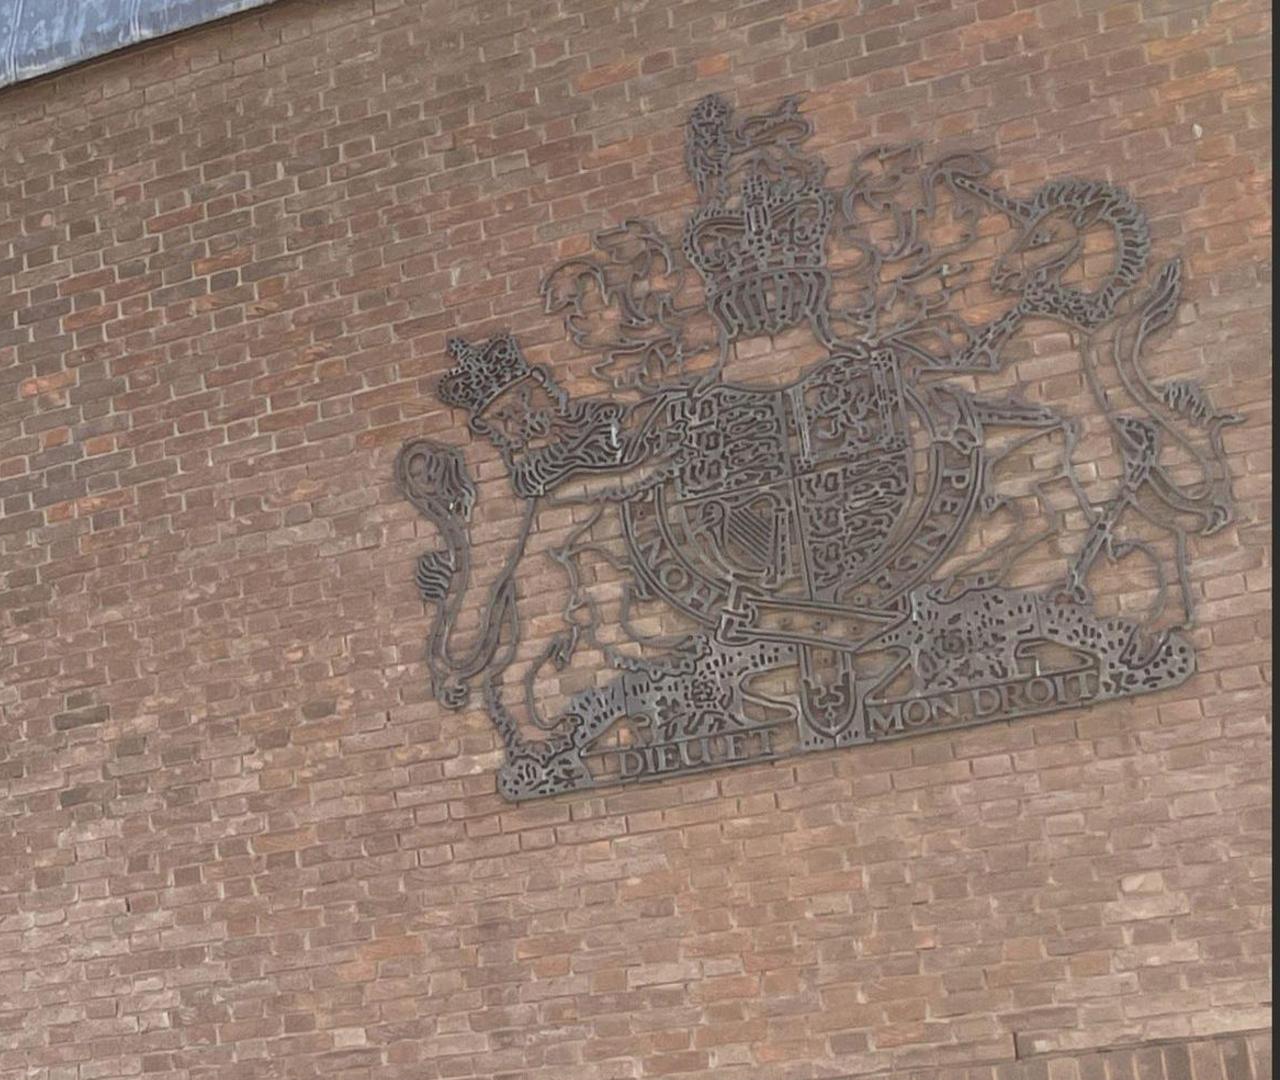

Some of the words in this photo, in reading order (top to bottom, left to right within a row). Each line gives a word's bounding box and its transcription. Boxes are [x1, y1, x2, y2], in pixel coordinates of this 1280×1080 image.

[619, 738, 712, 777] DIEU
[726, 730, 776, 761] ET
[866, 695, 961, 733] MON
[972, 670, 1100, 717] DROIT
